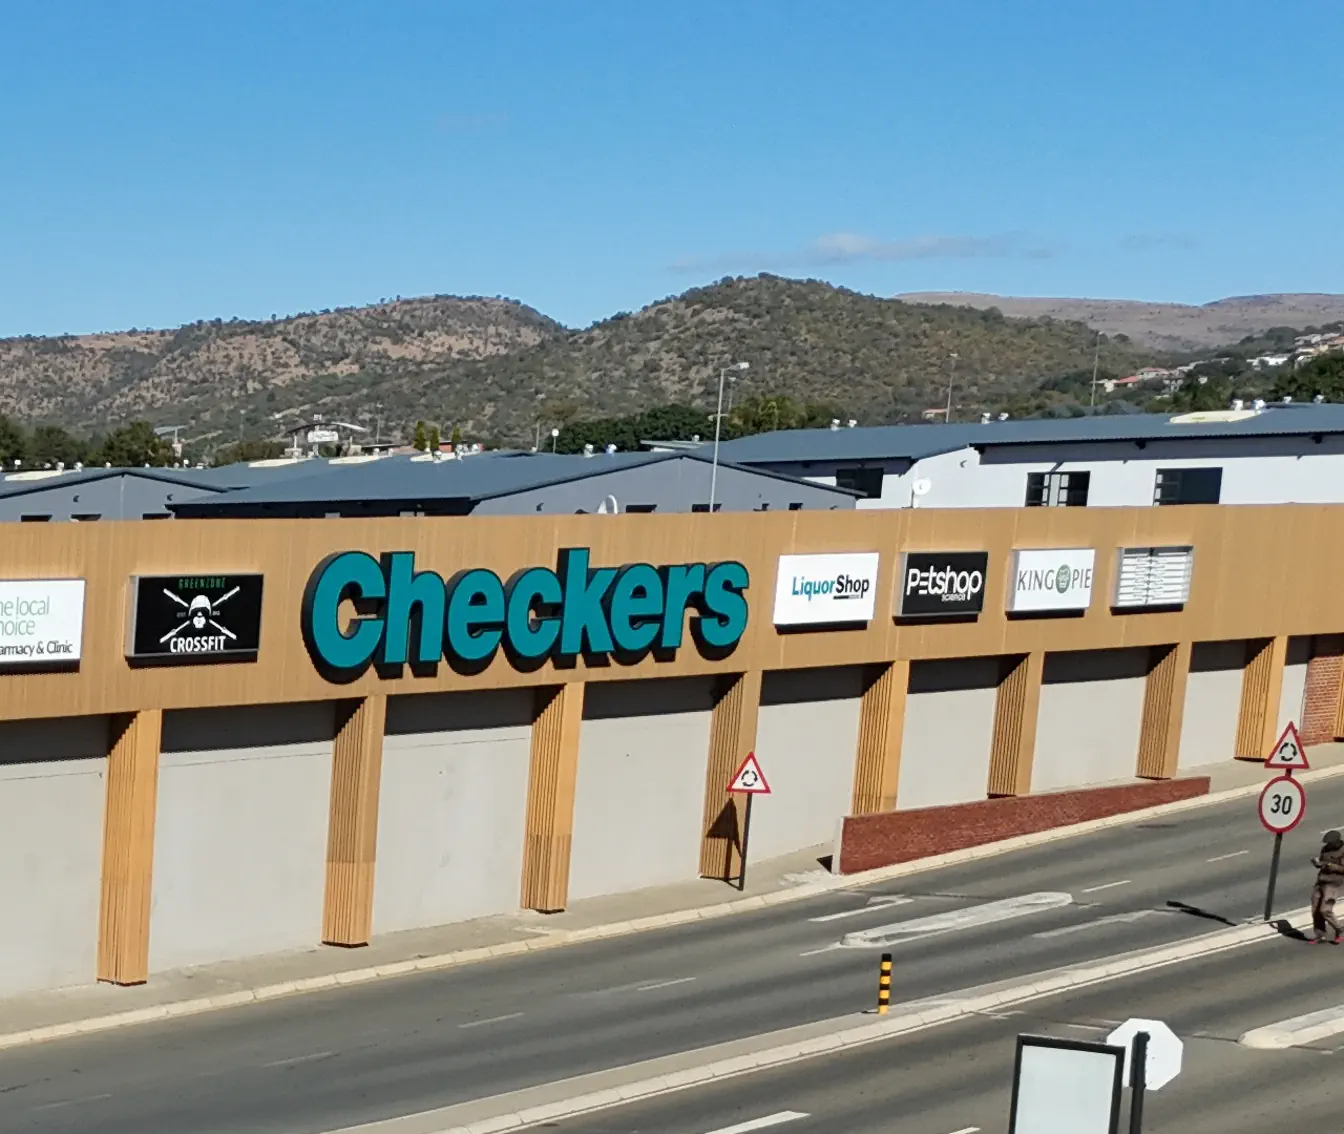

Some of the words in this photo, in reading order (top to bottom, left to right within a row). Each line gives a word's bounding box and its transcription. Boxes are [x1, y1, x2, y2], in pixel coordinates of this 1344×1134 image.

[1017, 569, 1055, 591] KING
[1071, 568, 1092, 589] PIE
[15, 595, 50, 616] local
[305, 548, 749, 680] Checkers
[36, 641, 45, 654] &
[46, 640, 73, 654] Clinic
[170, 636, 226, 653] CROSSFIT
[1271, 795, 1293, 816] 30
